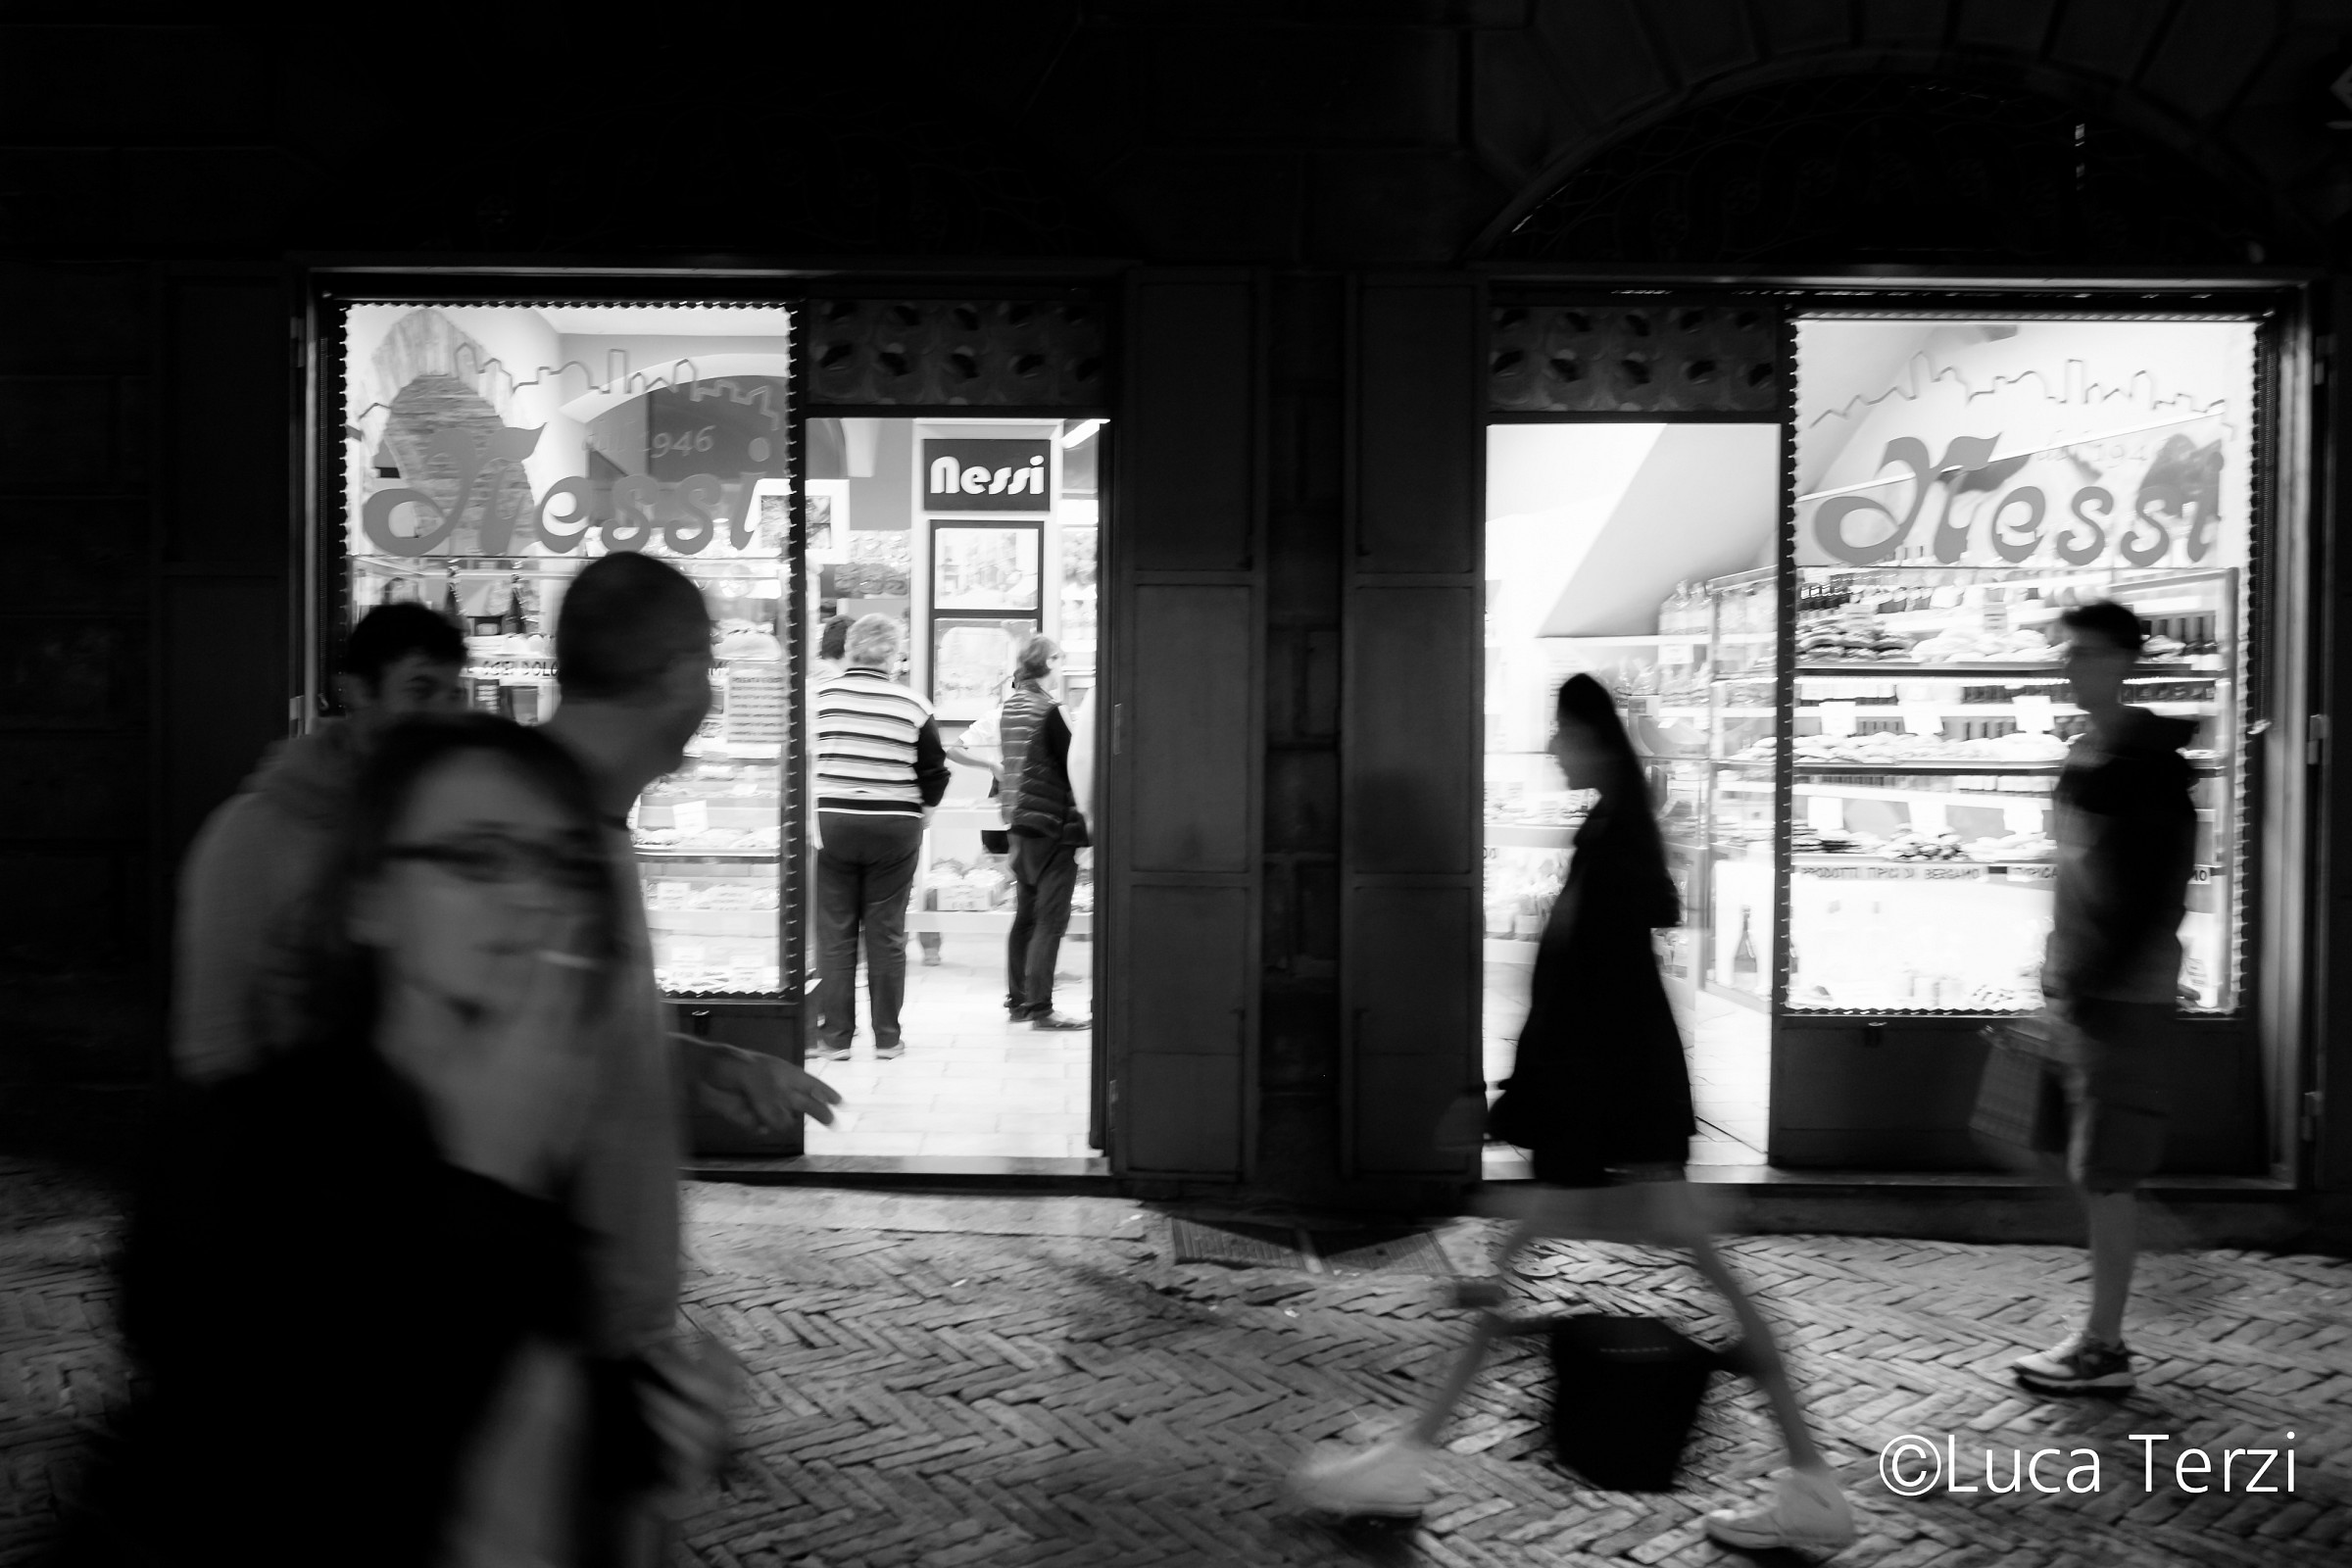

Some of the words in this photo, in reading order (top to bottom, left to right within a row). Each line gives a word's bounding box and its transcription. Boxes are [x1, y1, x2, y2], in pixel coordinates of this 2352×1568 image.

[363, 422, 774, 557] Nessi
[1814, 432, 2224, 565] Nessi
[1801, 866, 1857, 879] PRODOTTI
[1924, 867, 1980, 879] BERGAMO
[2011, 866, 2057, 879] TYPICA
